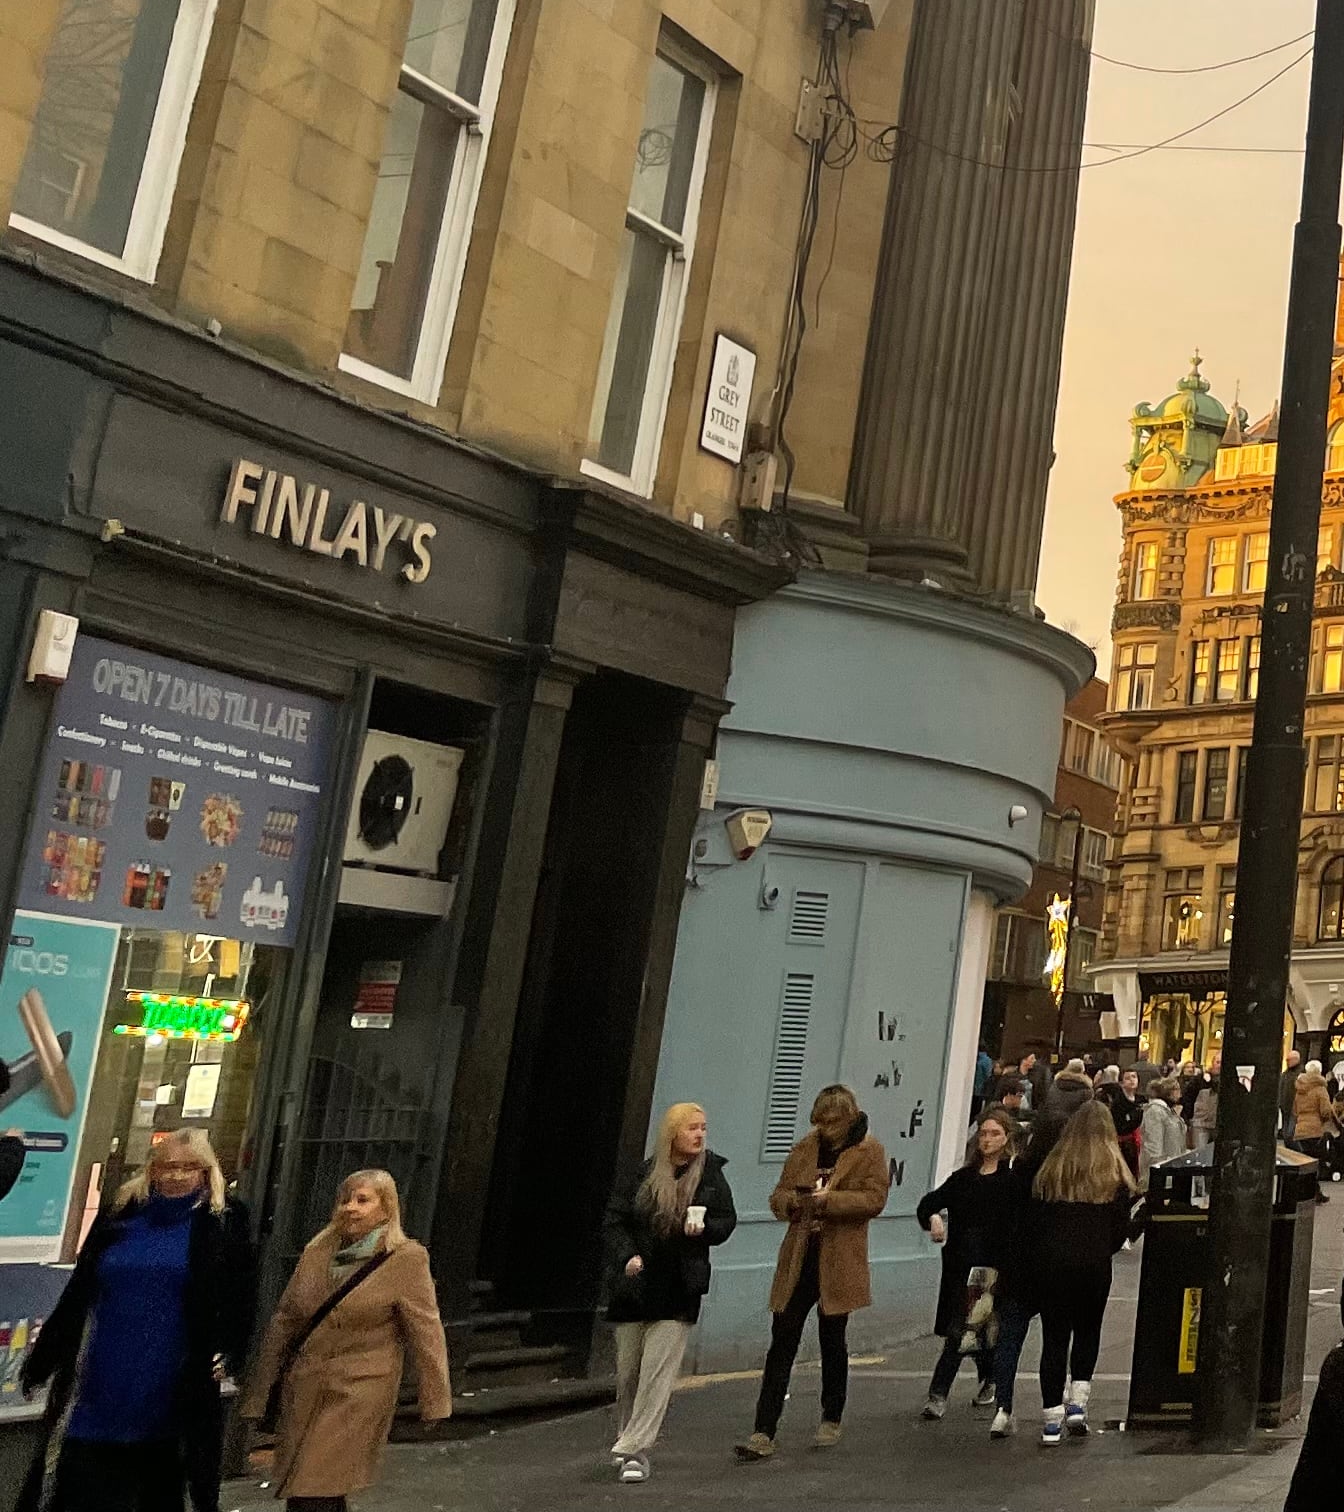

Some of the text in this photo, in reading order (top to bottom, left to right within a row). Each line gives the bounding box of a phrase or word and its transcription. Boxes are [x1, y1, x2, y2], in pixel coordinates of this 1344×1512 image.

[719, 385, 740, 408] GREY
[710, 407, 740, 433] STREET
[220, 459, 437, 583] FINLAY'S
[93, 658, 312, 744] OPEN 7 DAYS TILL LATE
[13, 949, 69, 976] IQOS
[1152, 972, 1228, 988] WATERSTON
